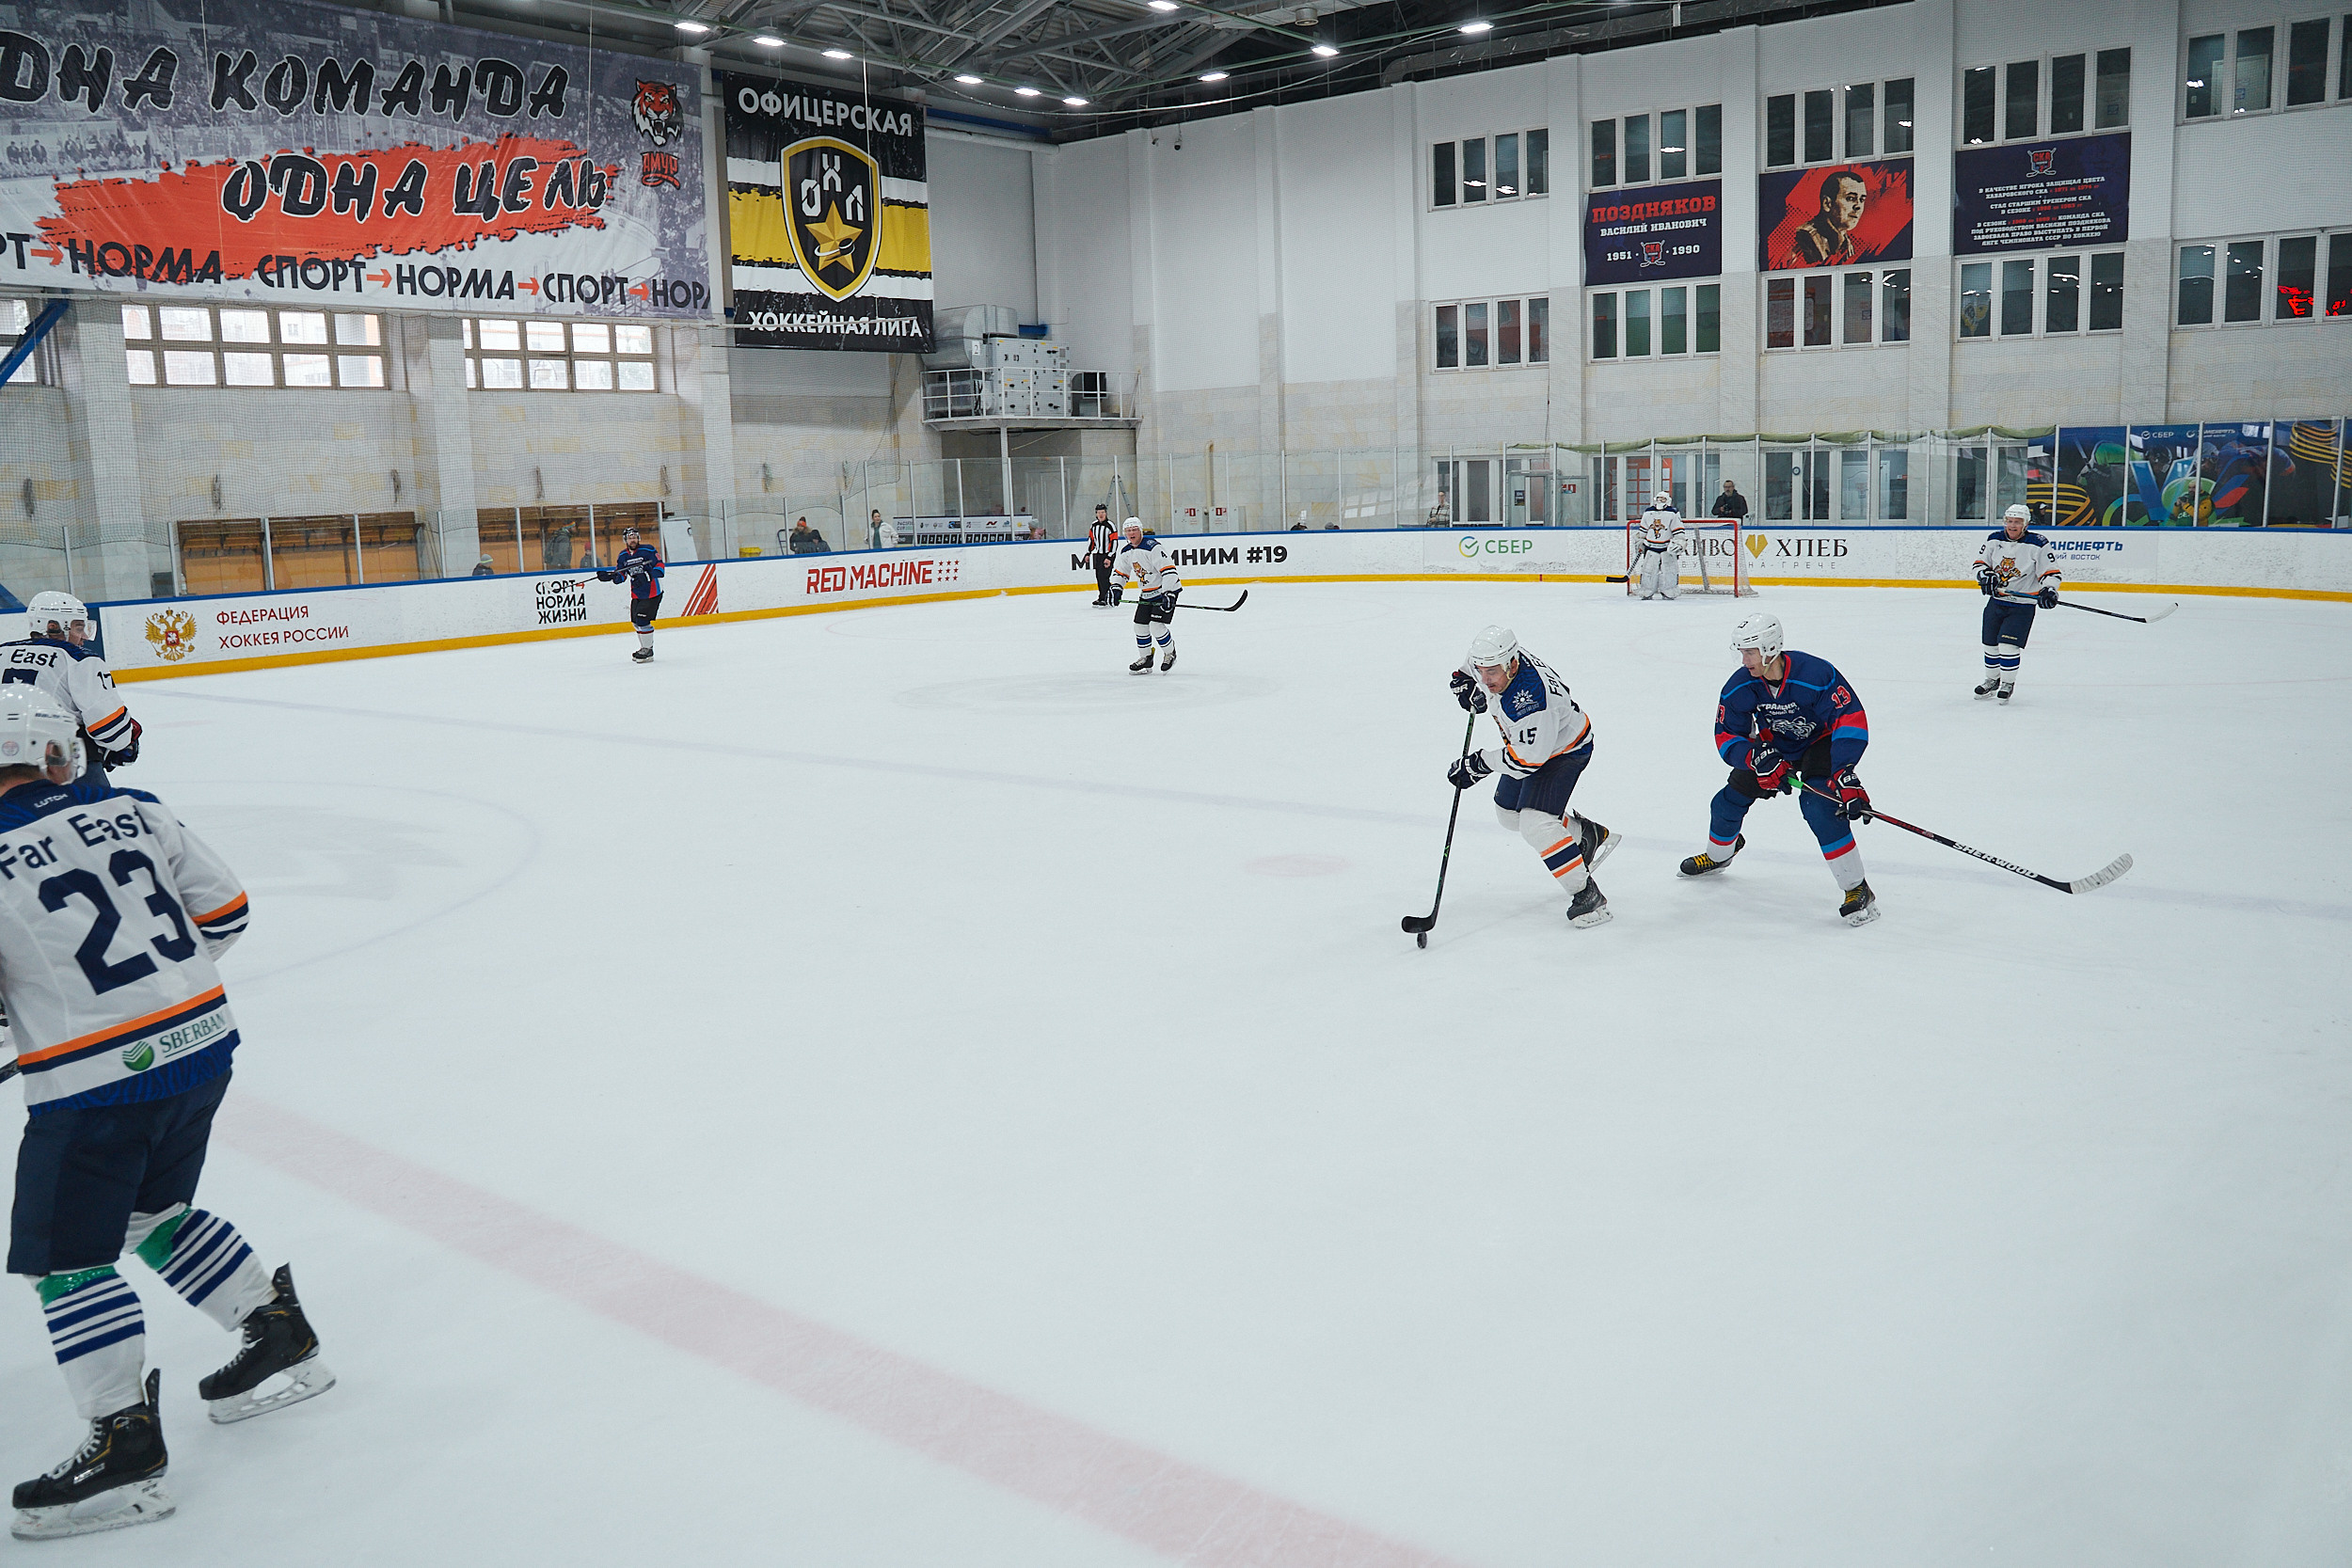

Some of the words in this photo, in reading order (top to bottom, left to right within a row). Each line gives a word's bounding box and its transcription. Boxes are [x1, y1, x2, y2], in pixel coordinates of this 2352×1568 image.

[212, 50, 569, 119] КОМАНДА
[738, 87, 914, 138] ОФИЦЕРСКАЯ
[642, 152, 678, 176] АМУР
[2033, 151, 2051, 162] СКА
[223, 155, 423, 222] ОДНА
[453, 157, 608, 222] ЦЕЛЬ
[1985, 184, 2018, 193] КАЧЕСТВЕ
[2046, 179, 2082, 187] ЗАЩИЩАЛ
[2083, 176, 2106, 184] ЦВЕТА
[1985, 190, 2034, 199] ХАБАРОВСКОГО
[2008, 199, 2041, 208] СТАРШИМ
[2042, 196, 2077, 205] ТРЕНЕРОМ
[1592, 195, 1717, 223] ПОЗДНЯКОВ
[2058, 213, 2090, 221] КОМАНДА
[1600, 222, 1648, 237] ВАСИЛИЙ
[1650, 217, 1708, 232] ИВАНОВИЧ
[1974, 232, 2010, 241] ЗАВОЕВАЛА
[2034, 227, 2074, 235] ВЫСТУПАТЬ
[1985, 224, 2035, 233] РУКОВОДСТВОМ
[2068, 217, 2111, 227] ПОЗДНЯКОВА
[1645, 243, 1661, 254] СКА
[2000, 236, 2043, 245] ЧЕМПИОНАТА
[1606, 250, 1632, 261] 1951
[1672, 245, 1700, 255] 1990
[69, 238, 222, 284] НОРМА
[258, 254, 366, 293] СПОРТ
[396, 264, 516, 300] НОРМА
[542, 276, 630, 306] СПОРТ
[748, 310, 869, 336] ХОККЕЙНАЯ
[874, 317, 923, 338] ЛИГА
[1247, 546, 1288, 564] #19
[1485, 539, 1534, 554] СБЕР
[1775, 538, 1849, 557] ХЛЕБ
[2050, 541, 2123, 551] АНСНЕФТЬ
[1161, 551, 1168, 560] 4
[2047, 552, 2055, 563] 9
[806, 566, 847, 594] RED
[850, 560, 934, 591] MACHINE
[536, 593, 585, 610] НОРМА
[216, 605, 310, 626] ФЕДЕРАЦИЯ
[538, 608, 587, 625] ЖИЗНИ
[218, 631, 279, 649] ХОККЕЯ
[283, 626, 349, 643] РОССИИ
[10, 648, 57, 668] East
[97, 671, 116, 689] 17
[1832, 685, 1851, 709] 13
[1518, 727, 1537, 745] 15
[34, 793, 68, 808] LUTCH
[0, 835, 57, 880] Far
[68, 805, 153, 847] East
[1953, 842, 2038, 879] SHER-WOOD
[39, 849, 197, 995] 23
